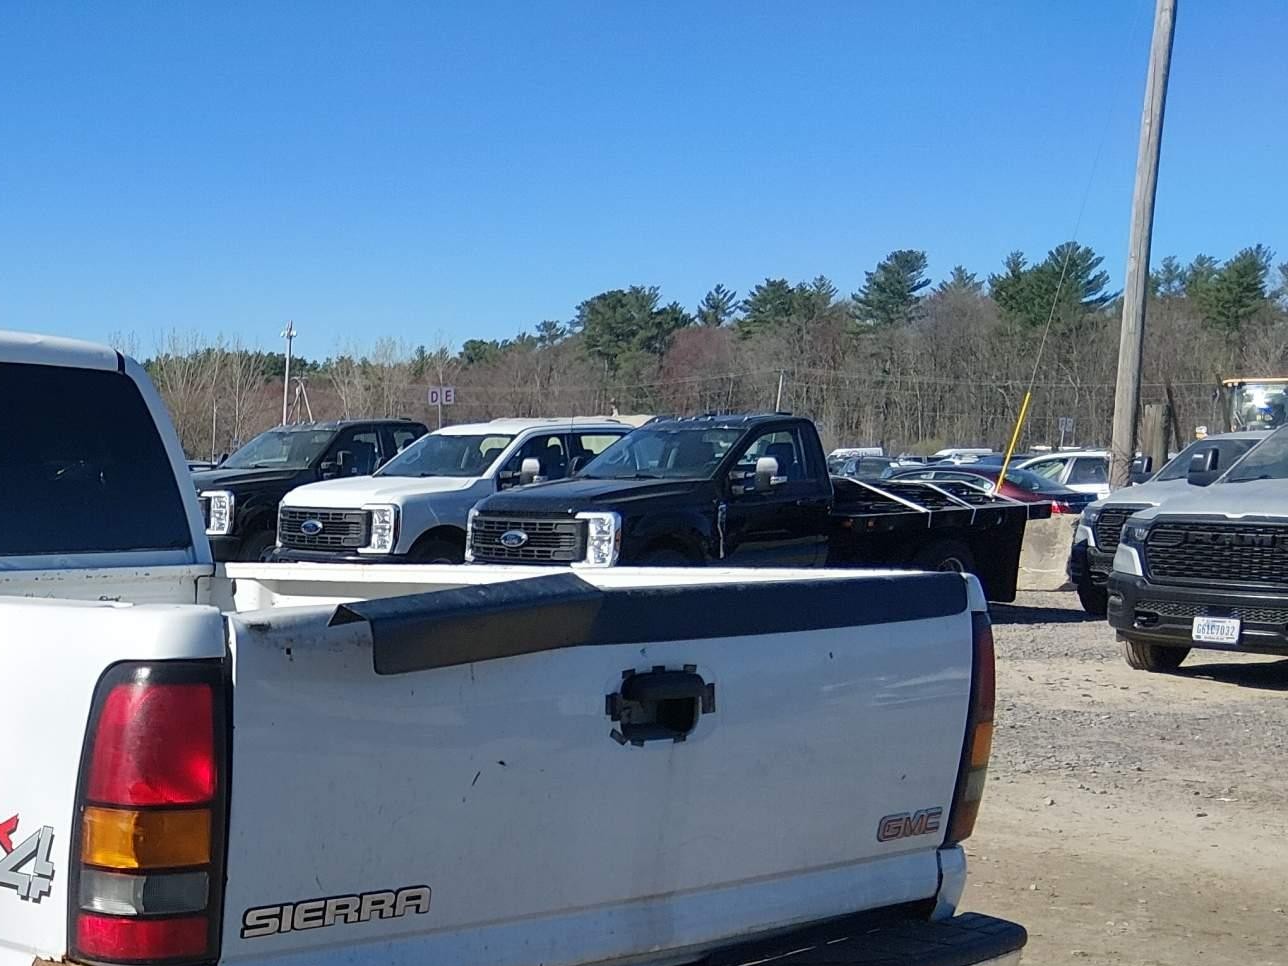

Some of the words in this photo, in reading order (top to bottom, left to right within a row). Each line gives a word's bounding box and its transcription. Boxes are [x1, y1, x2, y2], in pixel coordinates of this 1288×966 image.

[431, 391, 439, 403] D
[445, 390, 452, 402] E
[877, 806, 943, 842] GMC
[240, 885, 432, 939] SIERRA
